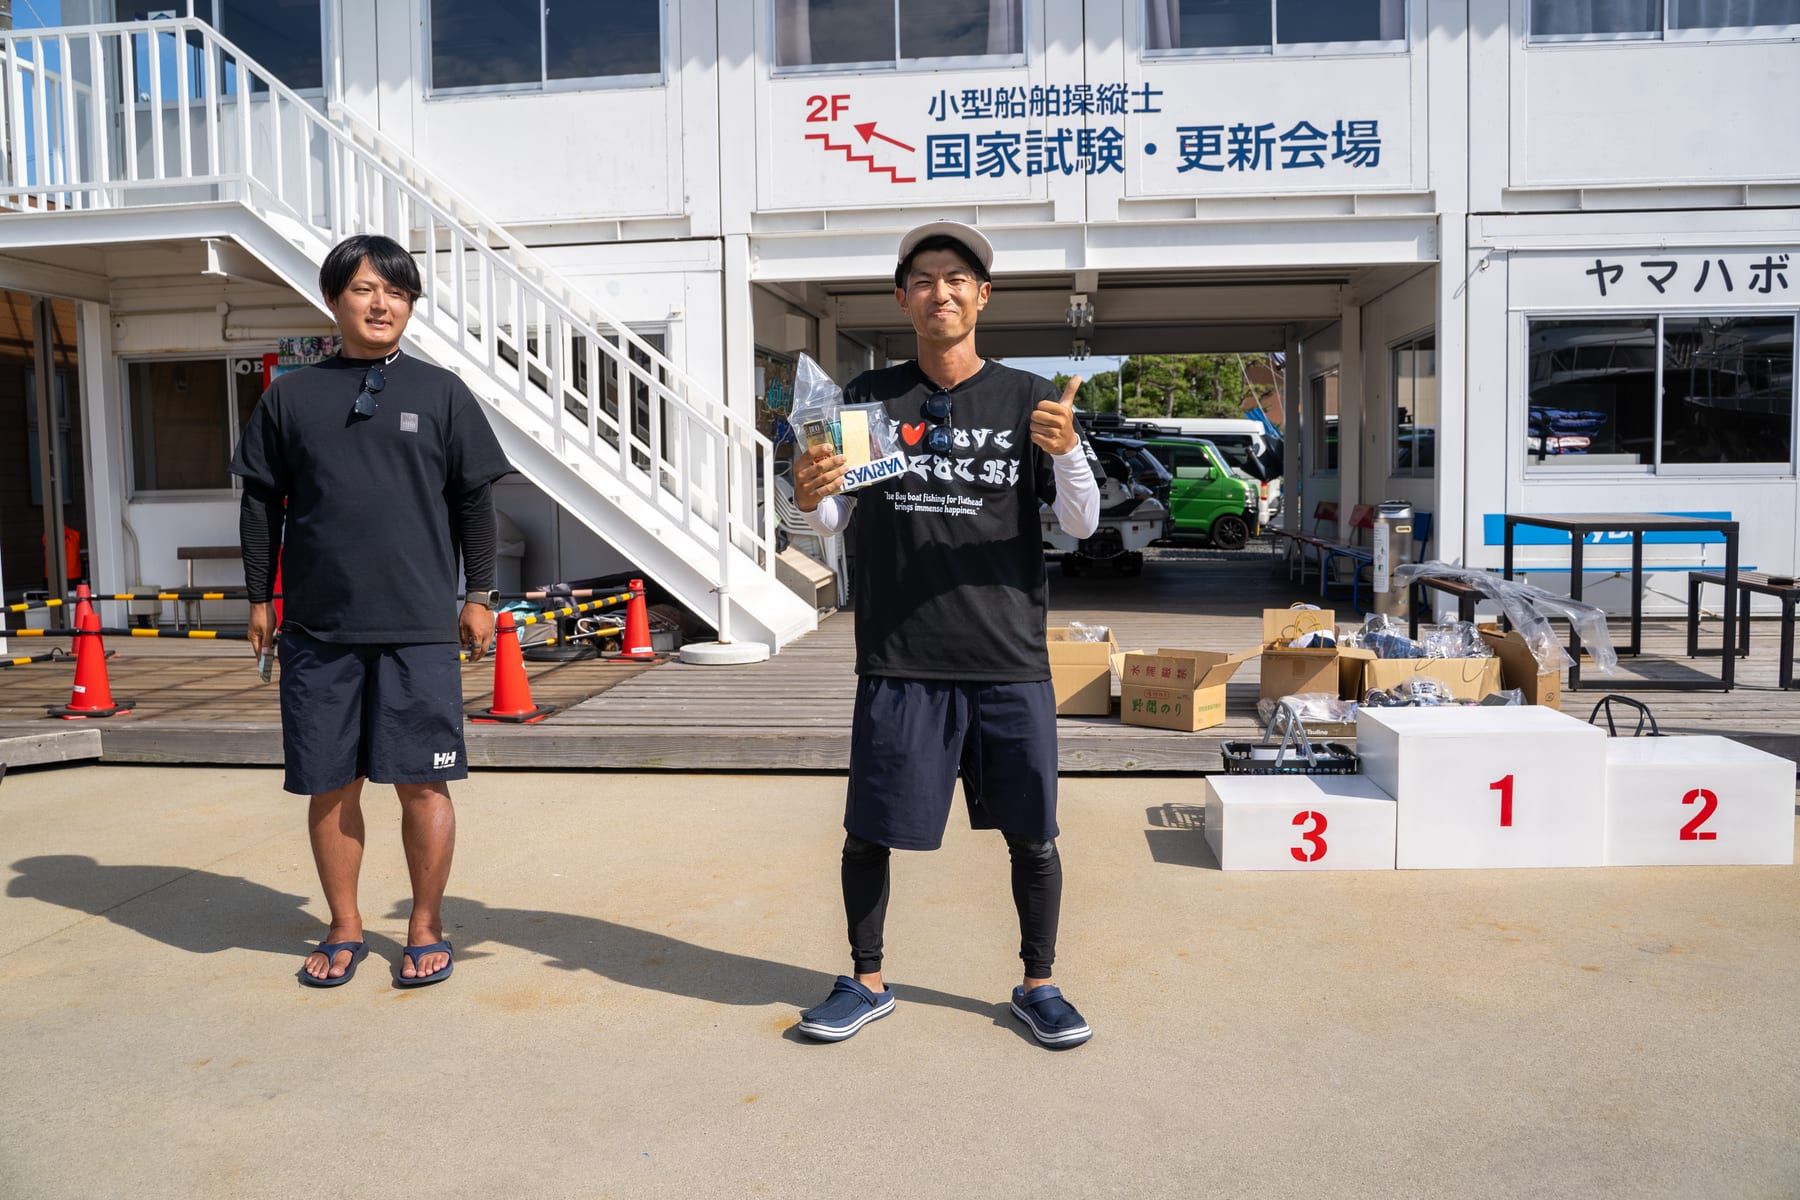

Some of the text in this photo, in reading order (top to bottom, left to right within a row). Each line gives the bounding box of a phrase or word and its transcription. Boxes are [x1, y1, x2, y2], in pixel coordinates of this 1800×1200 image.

[805, 94, 852, 123] 2F
[927, 82, 1164, 122] 小型船舶操縦士
[925, 119, 1382, 181] 国家試験・更新会場
[1585, 253, 1791, 297] ヤマハボ
[928, 424, 1013, 449] OVE
[843, 456, 905, 486] VARIVAS
[907, 492, 922, 502] boat
[914, 503, 943, 513] immense
[433, 751, 457, 766] HH
[1489, 774, 1515, 828] 1
[1679, 788, 1719, 841] 2
[1290, 810, 1328, 862] 3
